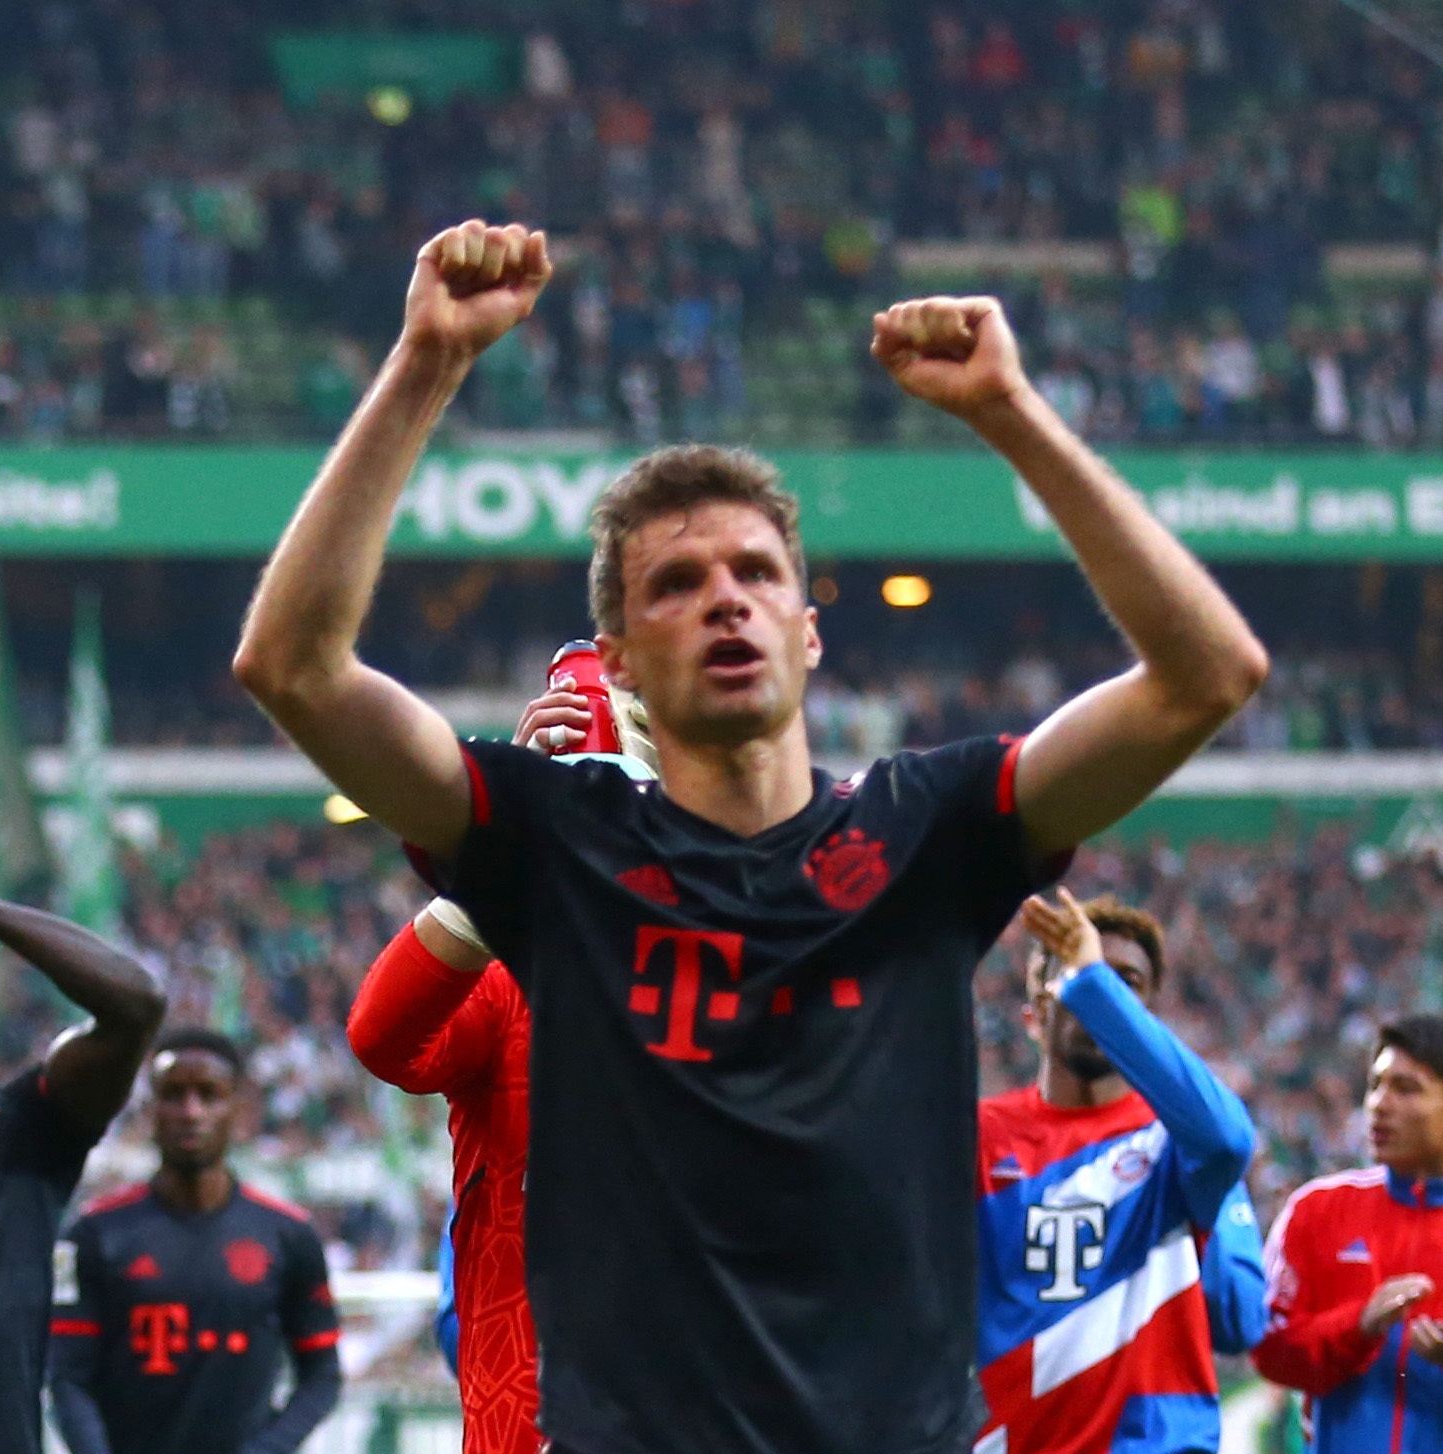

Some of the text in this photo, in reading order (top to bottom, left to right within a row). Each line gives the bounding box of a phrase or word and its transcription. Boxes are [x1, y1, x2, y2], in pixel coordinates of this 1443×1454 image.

[397, 458, 622, 541] HOY
[1308, 489, 1397, 536] an
[1026, 1204, 1105, 1301] T
